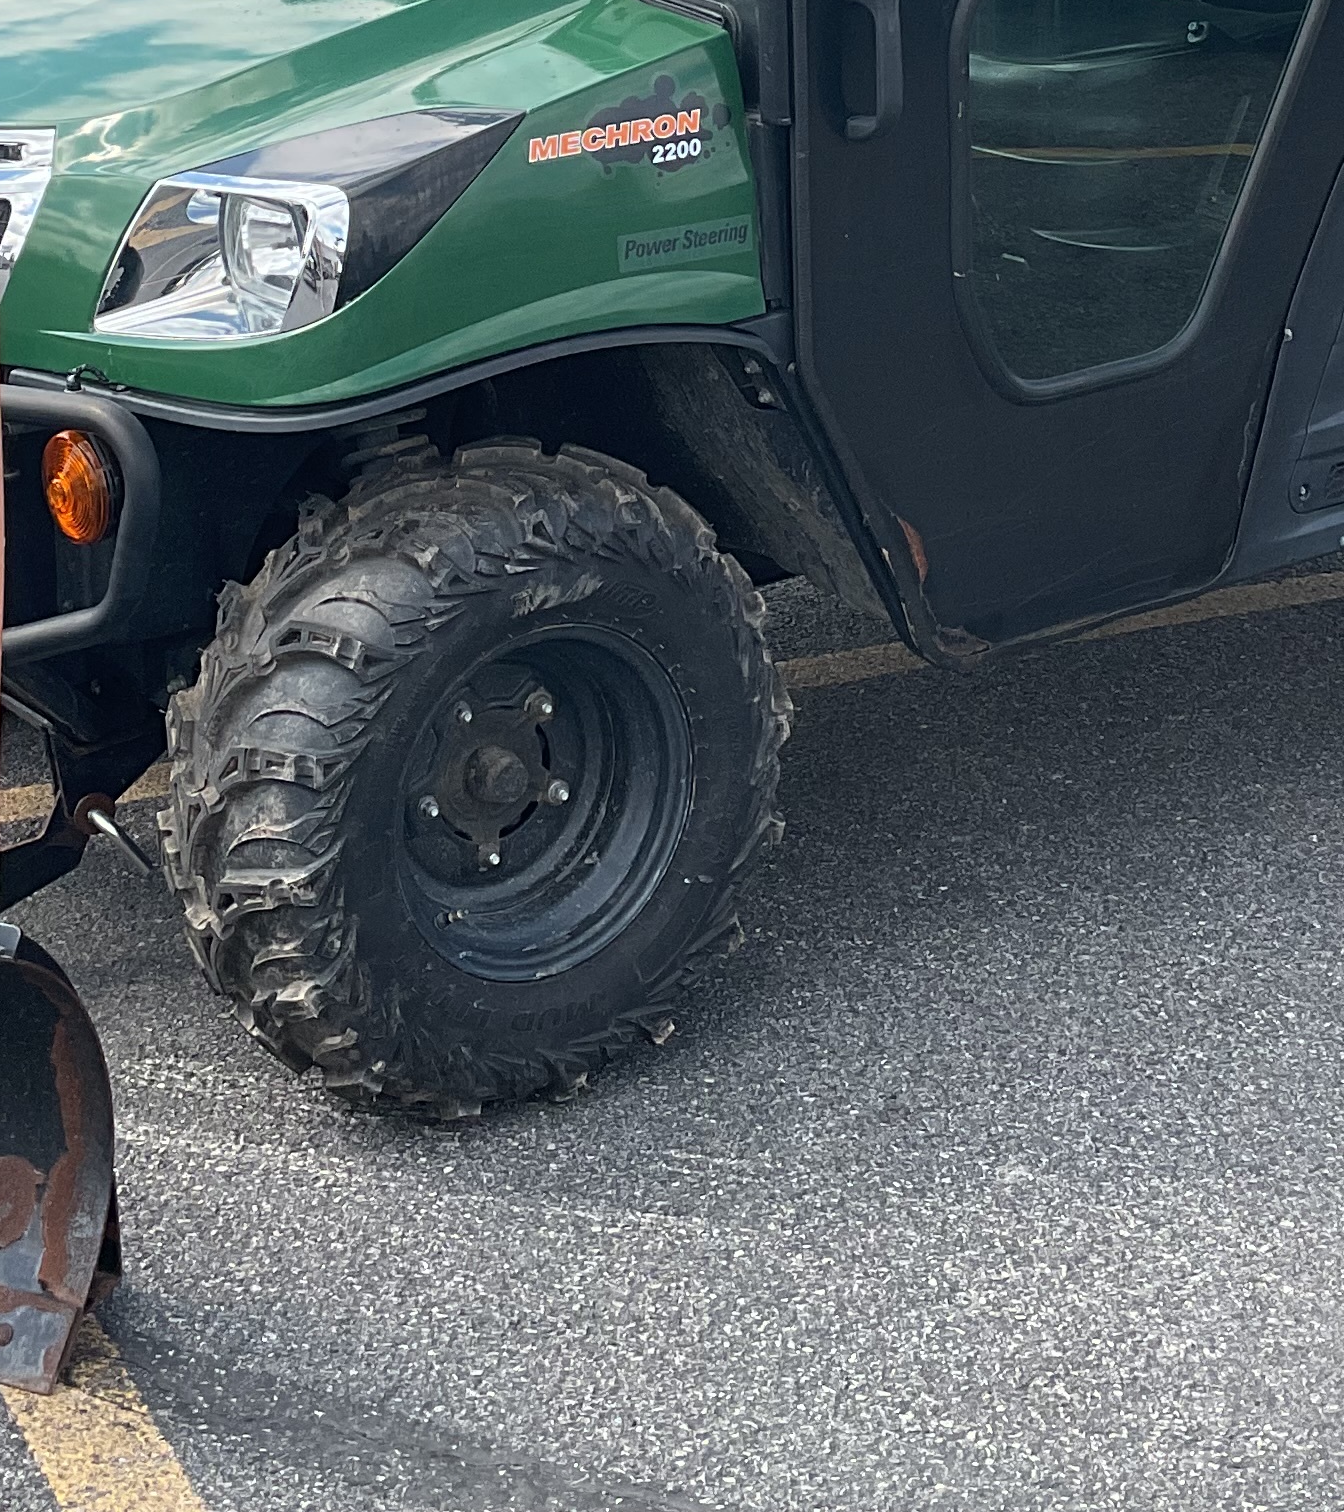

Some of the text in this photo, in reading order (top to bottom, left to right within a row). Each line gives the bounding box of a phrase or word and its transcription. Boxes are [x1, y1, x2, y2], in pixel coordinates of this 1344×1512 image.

[528, 109, 702, 163] MECHRON
[652, 138, 702, 164] 2200
[624, 222, 749, 261] Power Steering
